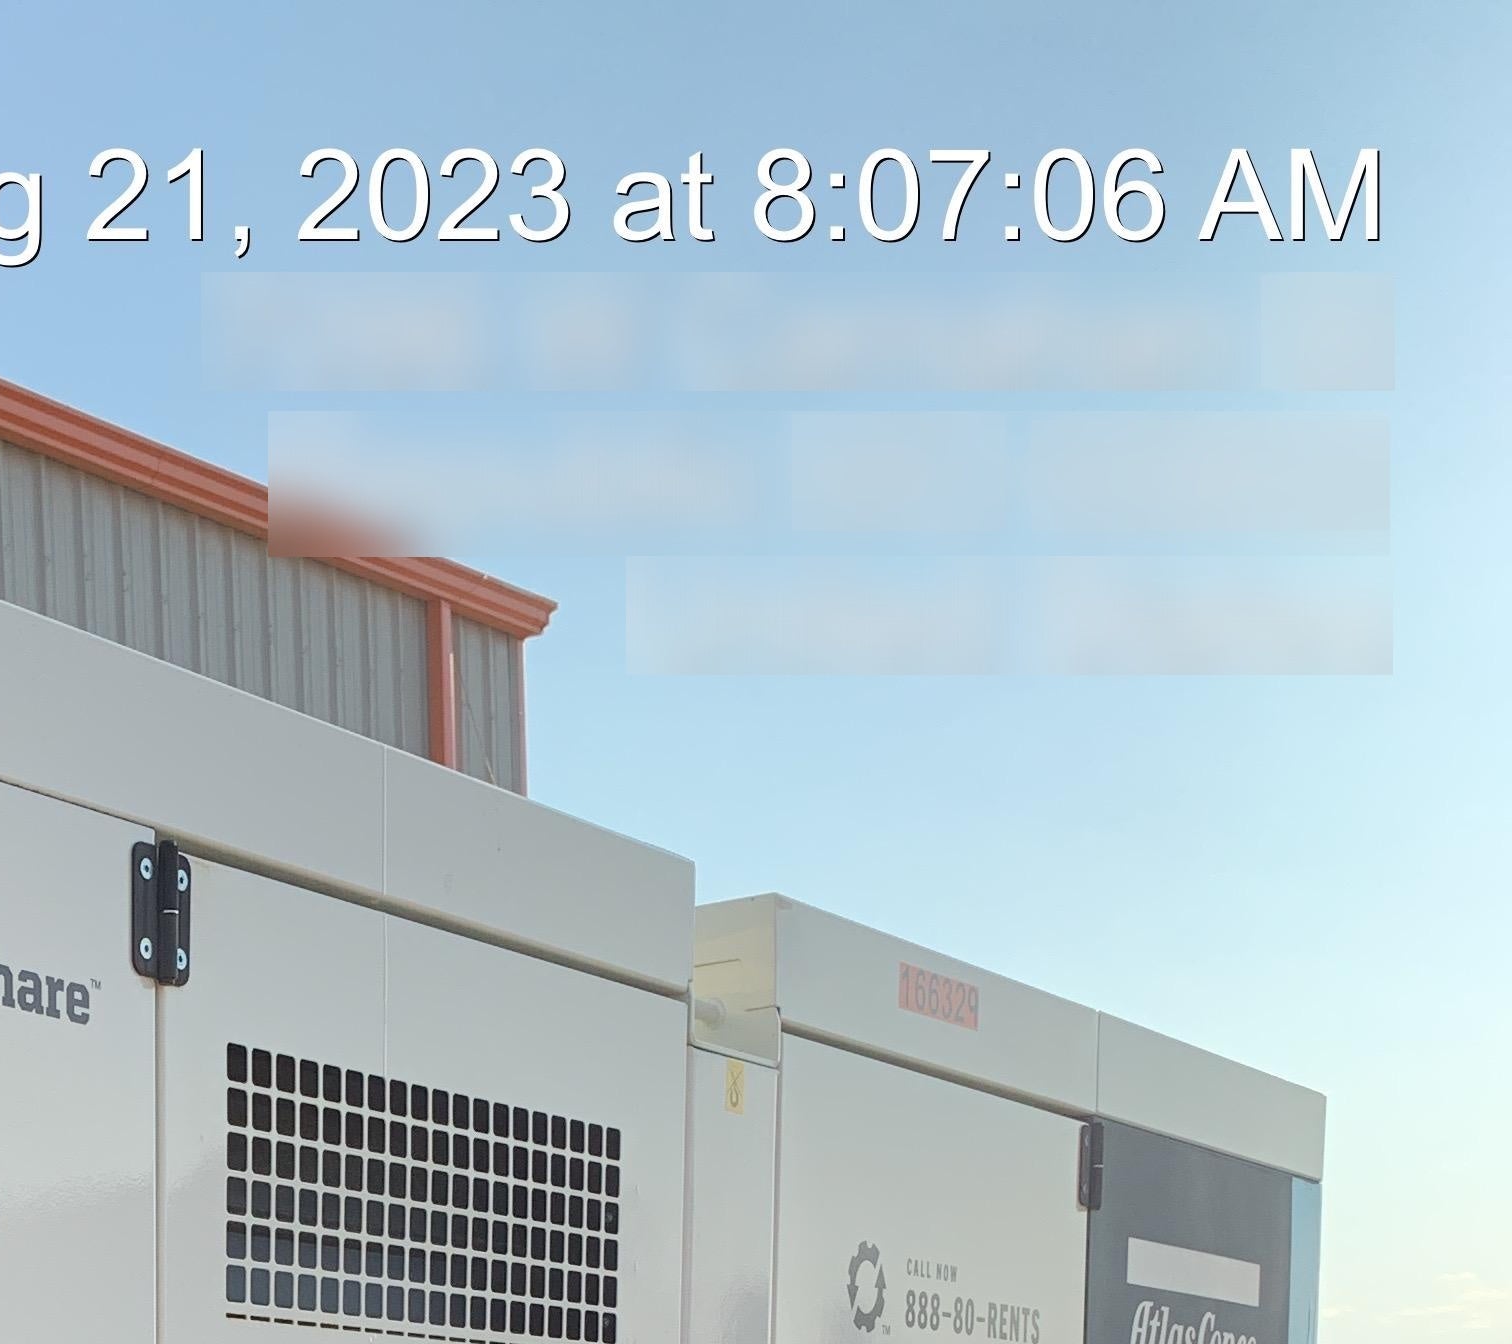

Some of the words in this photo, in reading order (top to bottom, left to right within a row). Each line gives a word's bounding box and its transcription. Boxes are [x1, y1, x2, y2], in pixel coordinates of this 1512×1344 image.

[902, 966, 978, 1030] 166329
[906, 1258, 931, 1278] CALL
[936, 1263, 958, 1282] NOW
[905, 1289, 1040, 1344] 888-80-RENTS
